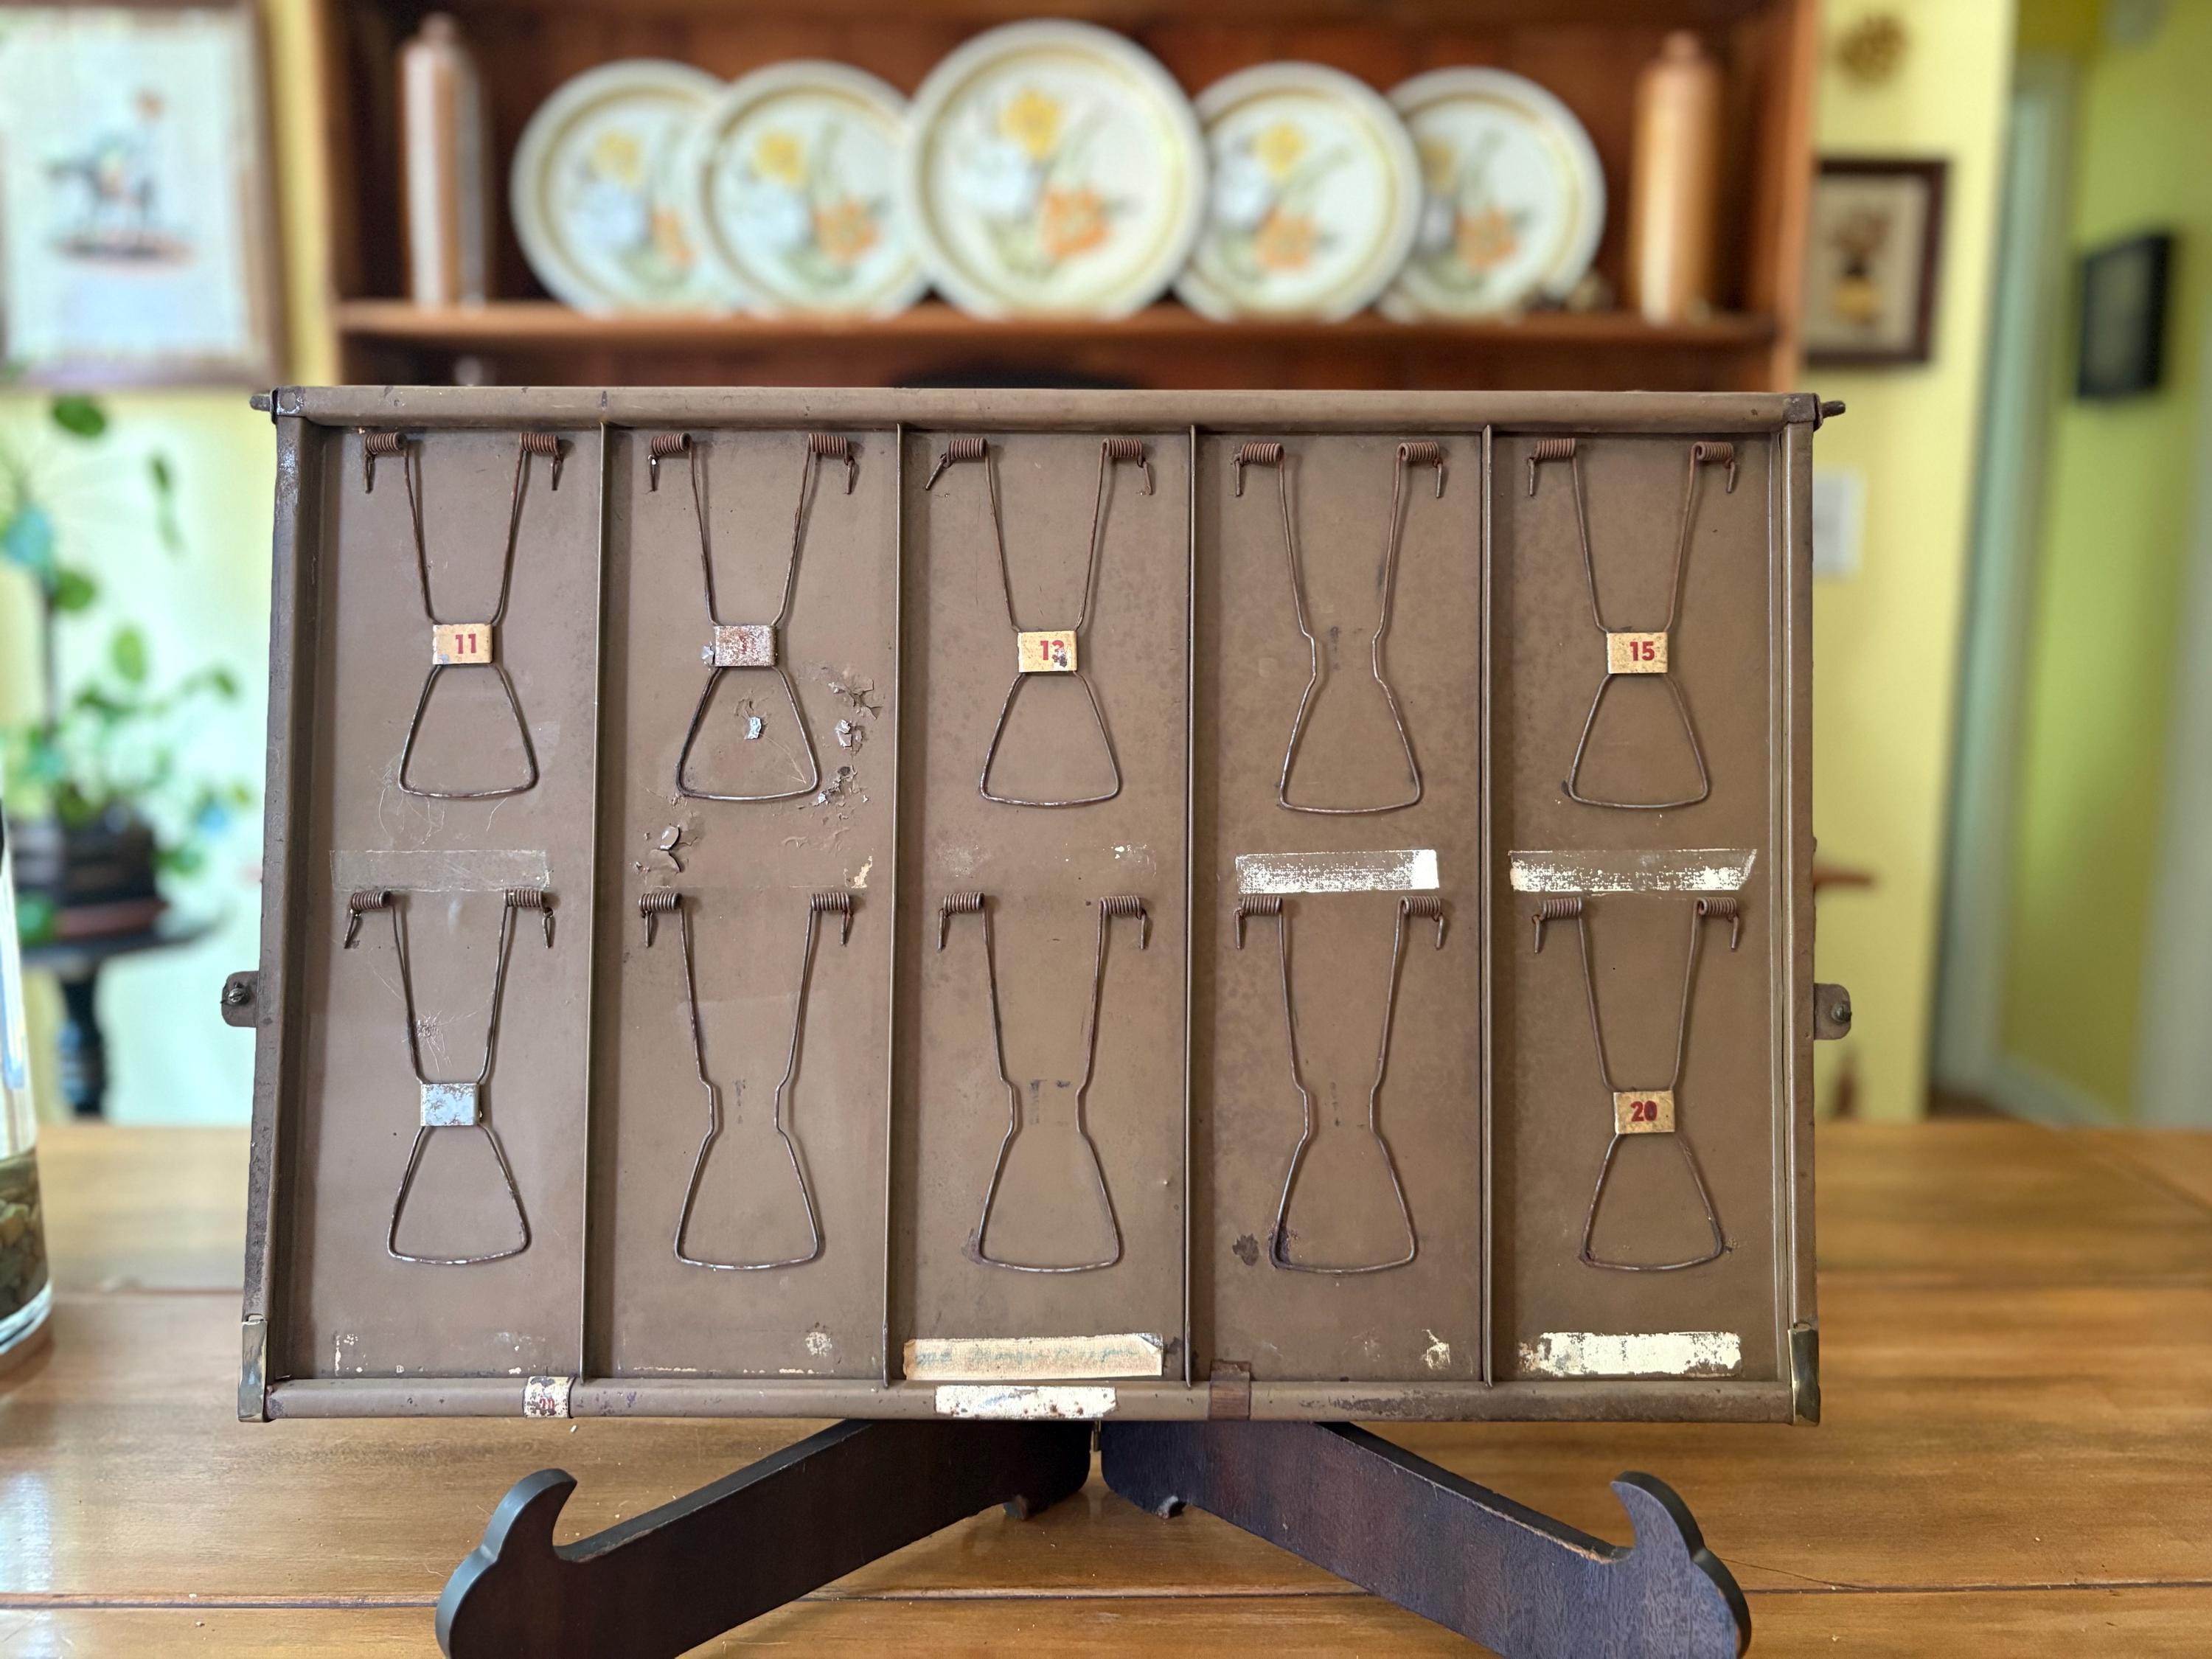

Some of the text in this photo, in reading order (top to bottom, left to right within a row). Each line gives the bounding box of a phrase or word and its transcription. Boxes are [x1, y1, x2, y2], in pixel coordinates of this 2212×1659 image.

[455, 633, 476, 655] 11
[1630, 641, 1655, 661] 15
[1630, 1100, 1658, 1122] 20
